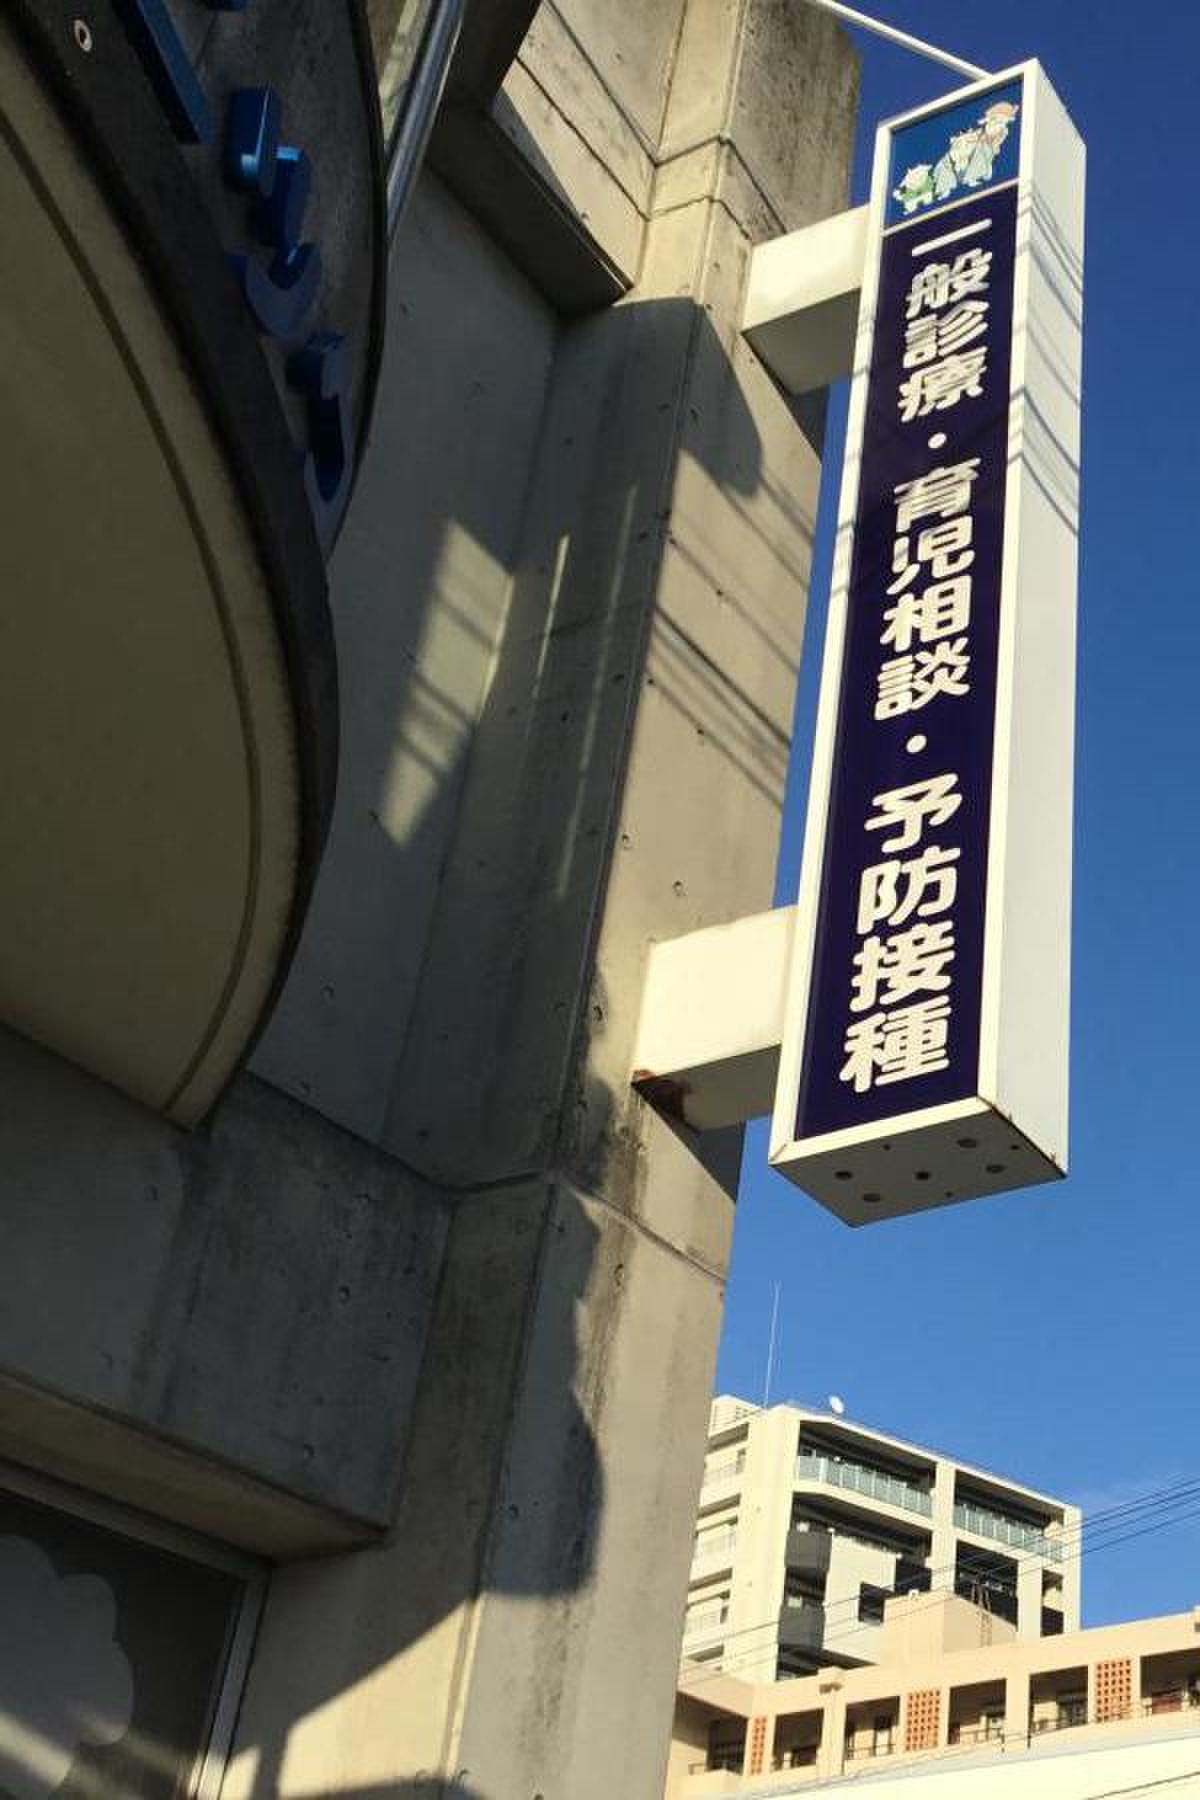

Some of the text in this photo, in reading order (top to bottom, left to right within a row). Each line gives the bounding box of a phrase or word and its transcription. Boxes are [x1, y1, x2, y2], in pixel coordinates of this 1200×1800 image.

[839, 217, 993, 1094] 一般診療・育児相談・予防接種
